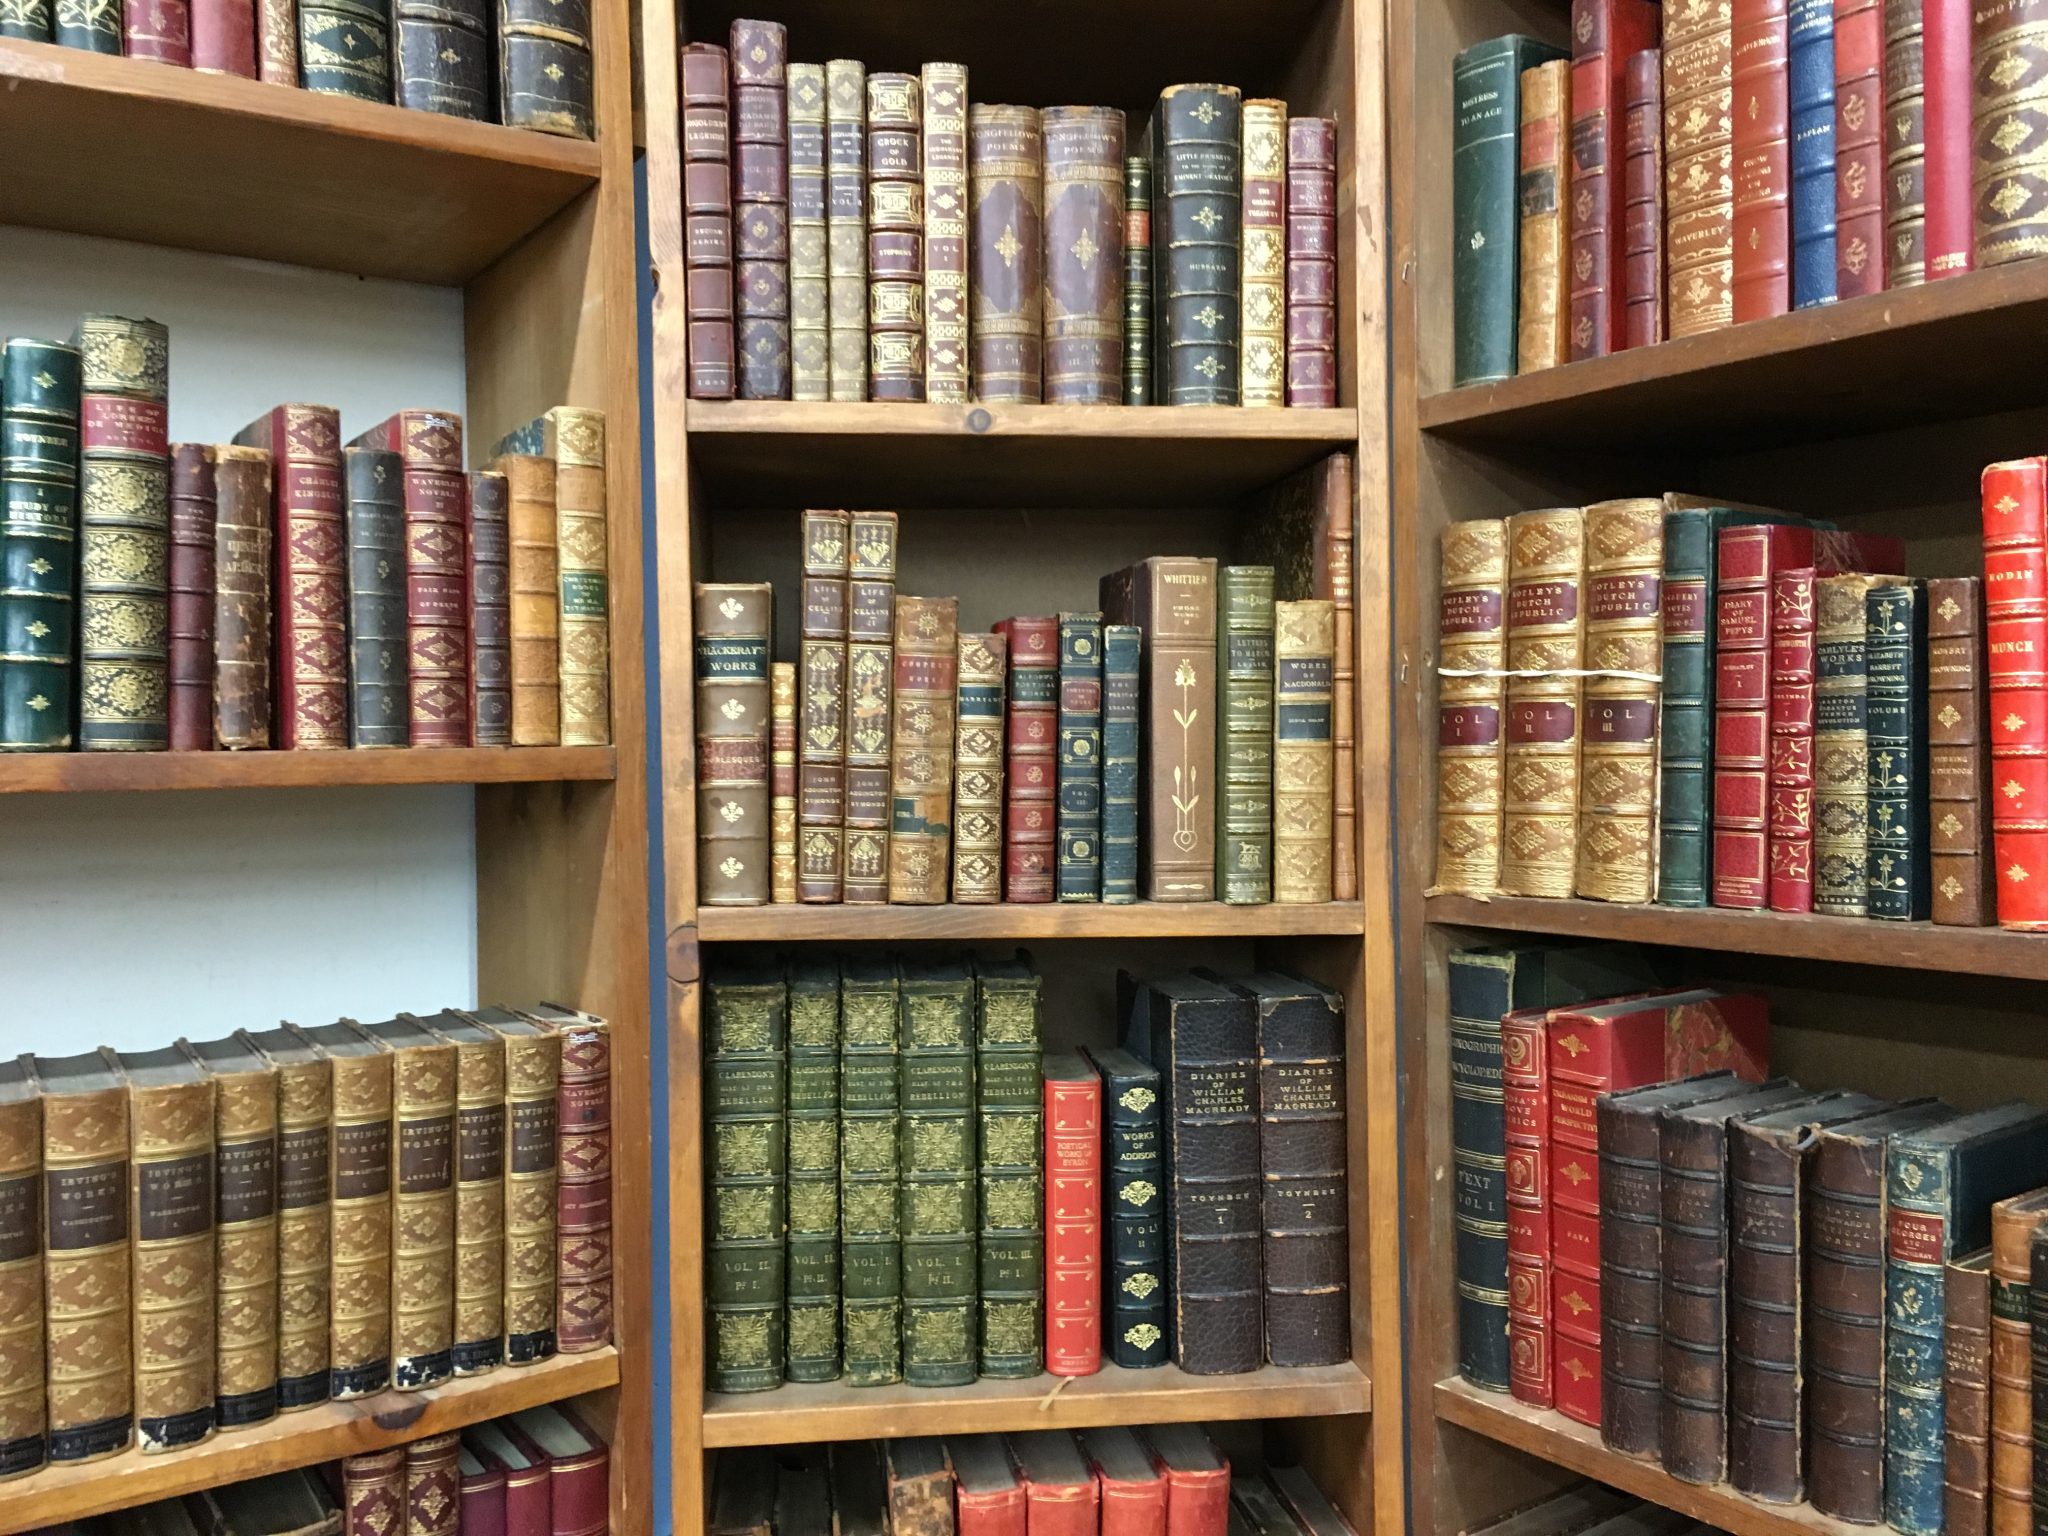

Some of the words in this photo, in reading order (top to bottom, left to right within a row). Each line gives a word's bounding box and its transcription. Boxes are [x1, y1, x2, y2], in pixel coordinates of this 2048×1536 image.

[1676, 54, 1719, 76] WORKS
[877, 138, 909, 146] CROCK
[986, 143, 1026, 151] POEMS
[881, 157, 908, 166] GOLD
[1176, 153, 1198, 161] LITTLE
[1174, 174, 1202, 182] EMINENT
[1674, 225, 1725, 245] WAVERLEY
[1163, 574, 1208, 585] WHITTIER
[860, 588, 885, 596] LIFE
[1597, 591, 1636, 601] DUTCH
[1516, 598, 1552, 609] DUTCH
[1590, 602, 1652, 613] REPUBLIC
[1725, 599, 1753, 609] DIARY
[853, 608, 889, 616] CELLINI
[1446, 606, 1481, 616] DUTCH
[1732, 609, 1744, 617] OF
[1720, 616, 1757, 626] SAMUEL
[1725, 626, 1754, 635] PEPYS
[1818, 645, 1865, 655] CARLYLE'S
[1991, 640, 2035, 654] MUNCH
[1820, 654, 1863, 663] WORKS
[709, 661, 757, 672] WORKS
[1290, 662, 1328, 670] WORKS
[1869, 663, 1903, 671] BARRETT
[1283, 680, 1331, 688] MACDONALD
[1868, 706, 1906, 714] VOLUME
[791, 1066, 839, 1075] CLARENDON'S
[844, 1066, 897, 1075] CLARENDON'S
[910, 1066, 963, 1075] CLARENDON'S
[983, 1062, 1036, 1071] CLARENDON'S
[718, 1070, 775, 1080] CLARENDON'S
[1190, 1071, 1246, 1081] DIARIES
[1278, 1067, 1334, 1077] DIARIES
[1300, 1077, 1313, 1085] OF
[562, 1085, 608, 1098] WAVERLEY
[1192, 1087, 1245, 1097] WILLIAM
[1280, 1084, 1332, 1094] WILLIAM
[1194, 1096, 1244, 1105] CHARLES
[1282, 1093, 1331, 1102] CHARLES
[1185, 1104, 1250, 1114] MACREADY
[1274, 1100, 1337, 1111] MACREADY
[1560, 1103, 1593, 1118] WORLD
[402, 1123, 450, 1136] IRVING'S
[1122, 1131, 1155, 1141] WORKS
[1057, 1142, 1092, 1150] POETICAL
[1132, 1142, 1144, 1150] OF
[1057, 1150, 1083, 1158] WORKS
[1119, 1151, 1157, 1161] ADDISON
[1062, 1158, 1089, 1167] BYRON
[60, 1171, 117, 1187] IRVING'S
[1458, 1170, 1492, 1190] TEXT
[60, 1186, 117, 1201] WORKS
[1190, 1192, 1250, 1202] TOYNBEE
[1277, 1188, 1336, 1198] TOYNBEE
[1304, 1210, 1312, 1219] 2
[1217, 1216, 1224, 1225] 1
